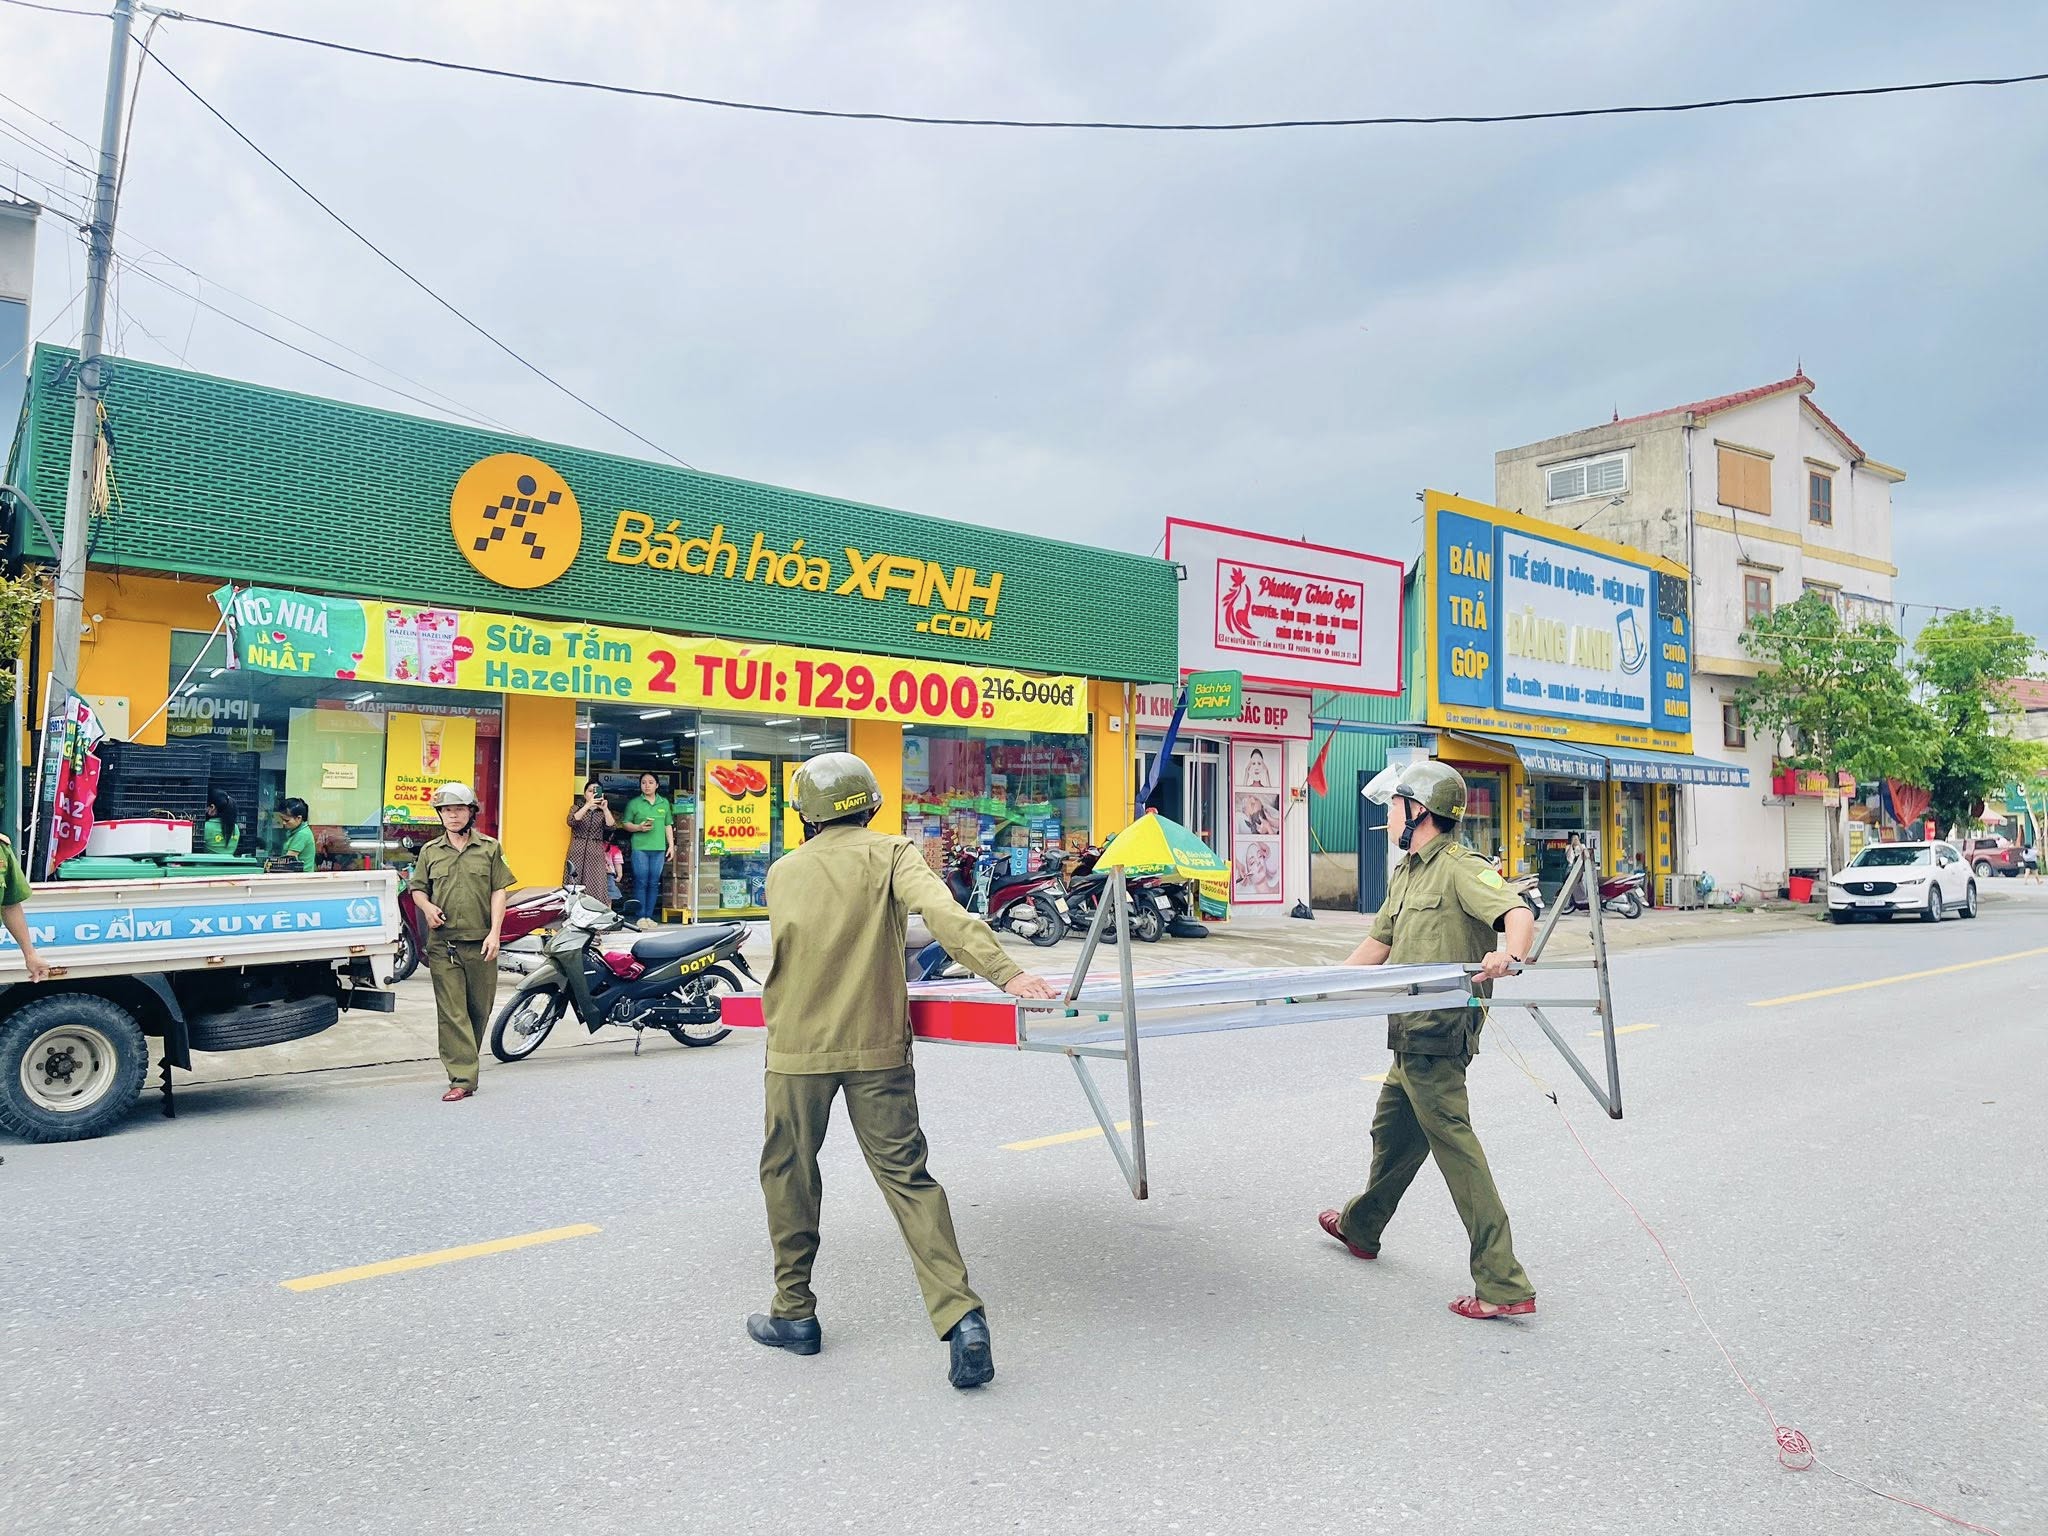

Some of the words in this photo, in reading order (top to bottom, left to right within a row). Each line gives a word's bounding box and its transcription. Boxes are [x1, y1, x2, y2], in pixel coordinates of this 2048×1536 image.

[606, 509, 738, 579] Bách
[744, 531, 831, 592] hóa
[833, 547, 1004, 617] XANH
[1449, 541, 1491, 582] BÁN
[1509, 549, 1530, 578] THẾ
[1530, 556, 1552, 586] GIỚI
[1554, 566, 1565, 588] DI
[1567, 567, 1595, 597] ĐỘNG
[1602, 576, 1624, 606] ĐIỆN
[1626, 583, 1645, 608] MÁY
[1305, 583, 1333, 605] Thảo
[1335, 589, 1356, 612] Spa
[1449, 591, 1488, 630] TRẢ
[276, 599, 328, 638] NHÀ
[915, 614, 993, 640] .COM
[486, 624, 551, 656] Sữa
[563, 627, 632, 663] Tắm
[1507, 604, 1567, 664] ĐĂNG
[1570, 624, 1613, 672] ANH
[1663, 641, 1687, 663] CHỮA
[247, 642, 315, 672] NHẤT
[1451, 641, 1489, 679] GÓP
[485, 660, 632, 697] Hazeline
[647, 650, 677, 693] 2
[694, 649, 788, 702] TÚI:
[795, 660, 979, 719] 129.000
[1195, 684, 1215, 694] Bách
[1216, 683, 1231, 693] hóa
[1666, 666, 1684, 690] BẢO
[1193, 696, 1230, 709] XANH
[1237, 697, 1261, 723] SẮC
[1264, 706, 1288, 730] ĐẸP
[1664, 695, 1689, 717] HÀNH
[72, 802, 84, 818] 2
[719, 804, 733, 814] Cá
[736, 803, 755, 814] Hồi
[834, 792, 867, 810] BVANTT
[708, 825, 755, 838] 45.000
[75, 913, 172, 940] CẨM
[189, 910, 322, 934] XUYÊN
[681, 953, 715, 974] DQTV
